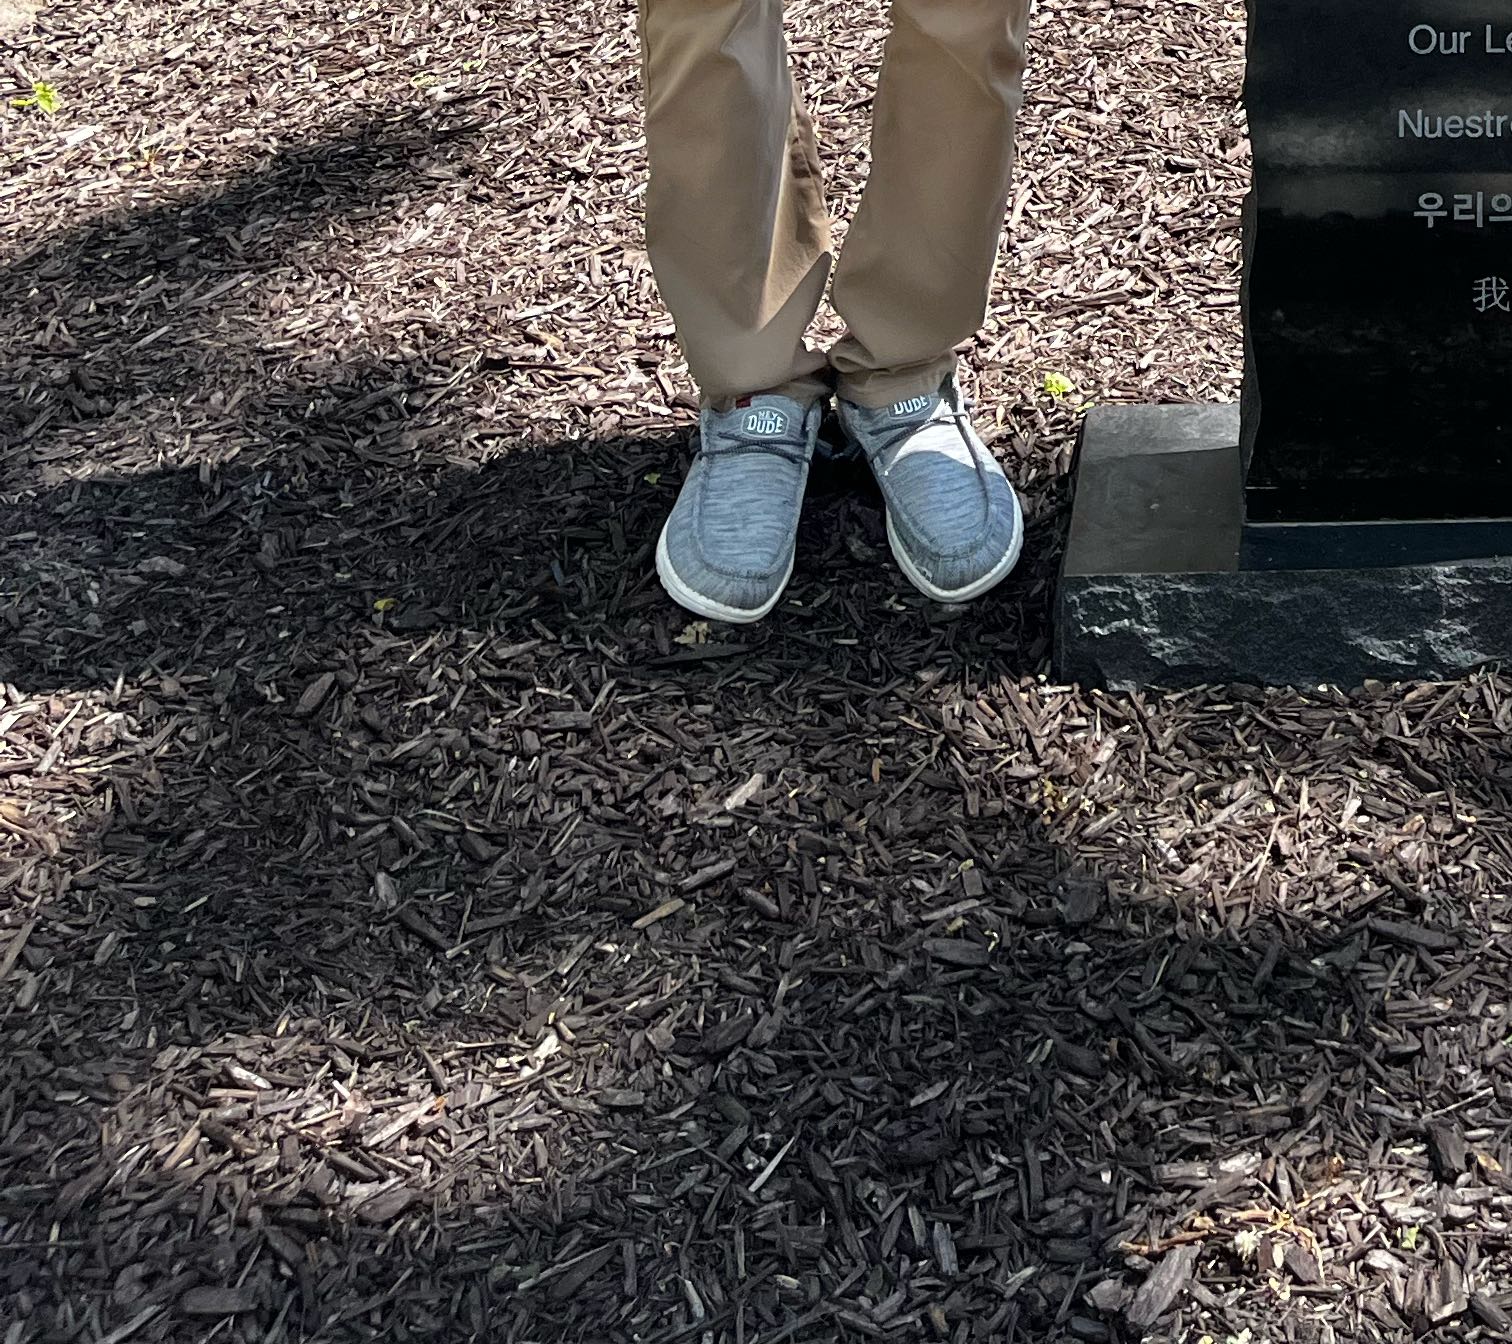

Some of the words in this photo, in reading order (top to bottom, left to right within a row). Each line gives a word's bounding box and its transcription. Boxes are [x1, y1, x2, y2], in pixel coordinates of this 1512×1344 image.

[1408, 23, 1471, 55] Our
[893, 394, 928, 415] DUDE
[747, 413, 783, 434] DUDE
